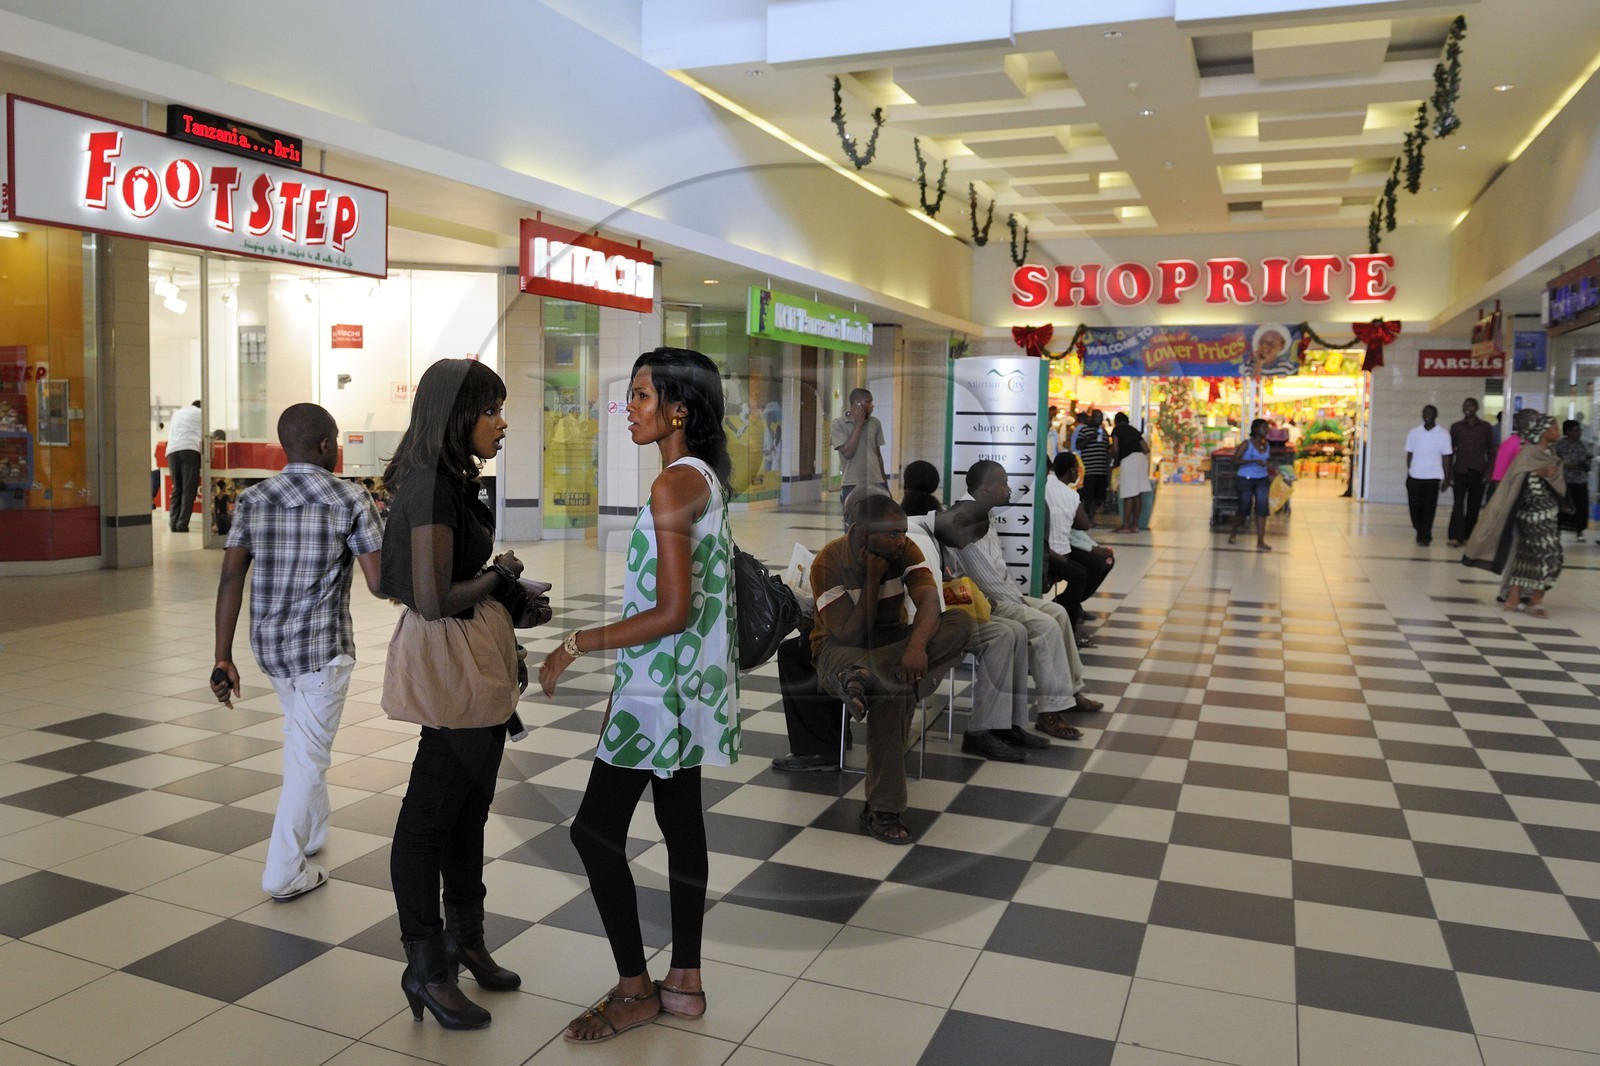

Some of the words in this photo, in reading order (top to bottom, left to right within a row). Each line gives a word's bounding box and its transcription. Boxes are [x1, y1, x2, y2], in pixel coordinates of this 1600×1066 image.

[1012, 254, 1397, 309] SHOPRITE
[1087, 338, 1139, 355] WELCOME
[1139, 327, 1153, 343] TO
[1145, 344, 1193, 368] Lower
[1196, 336, 1246, 360] Prices
[1423, 357, 1503, 370] PARCELS
[973, 423, 1015, 435] shoprite
[978, 453, 1007, 461] game
